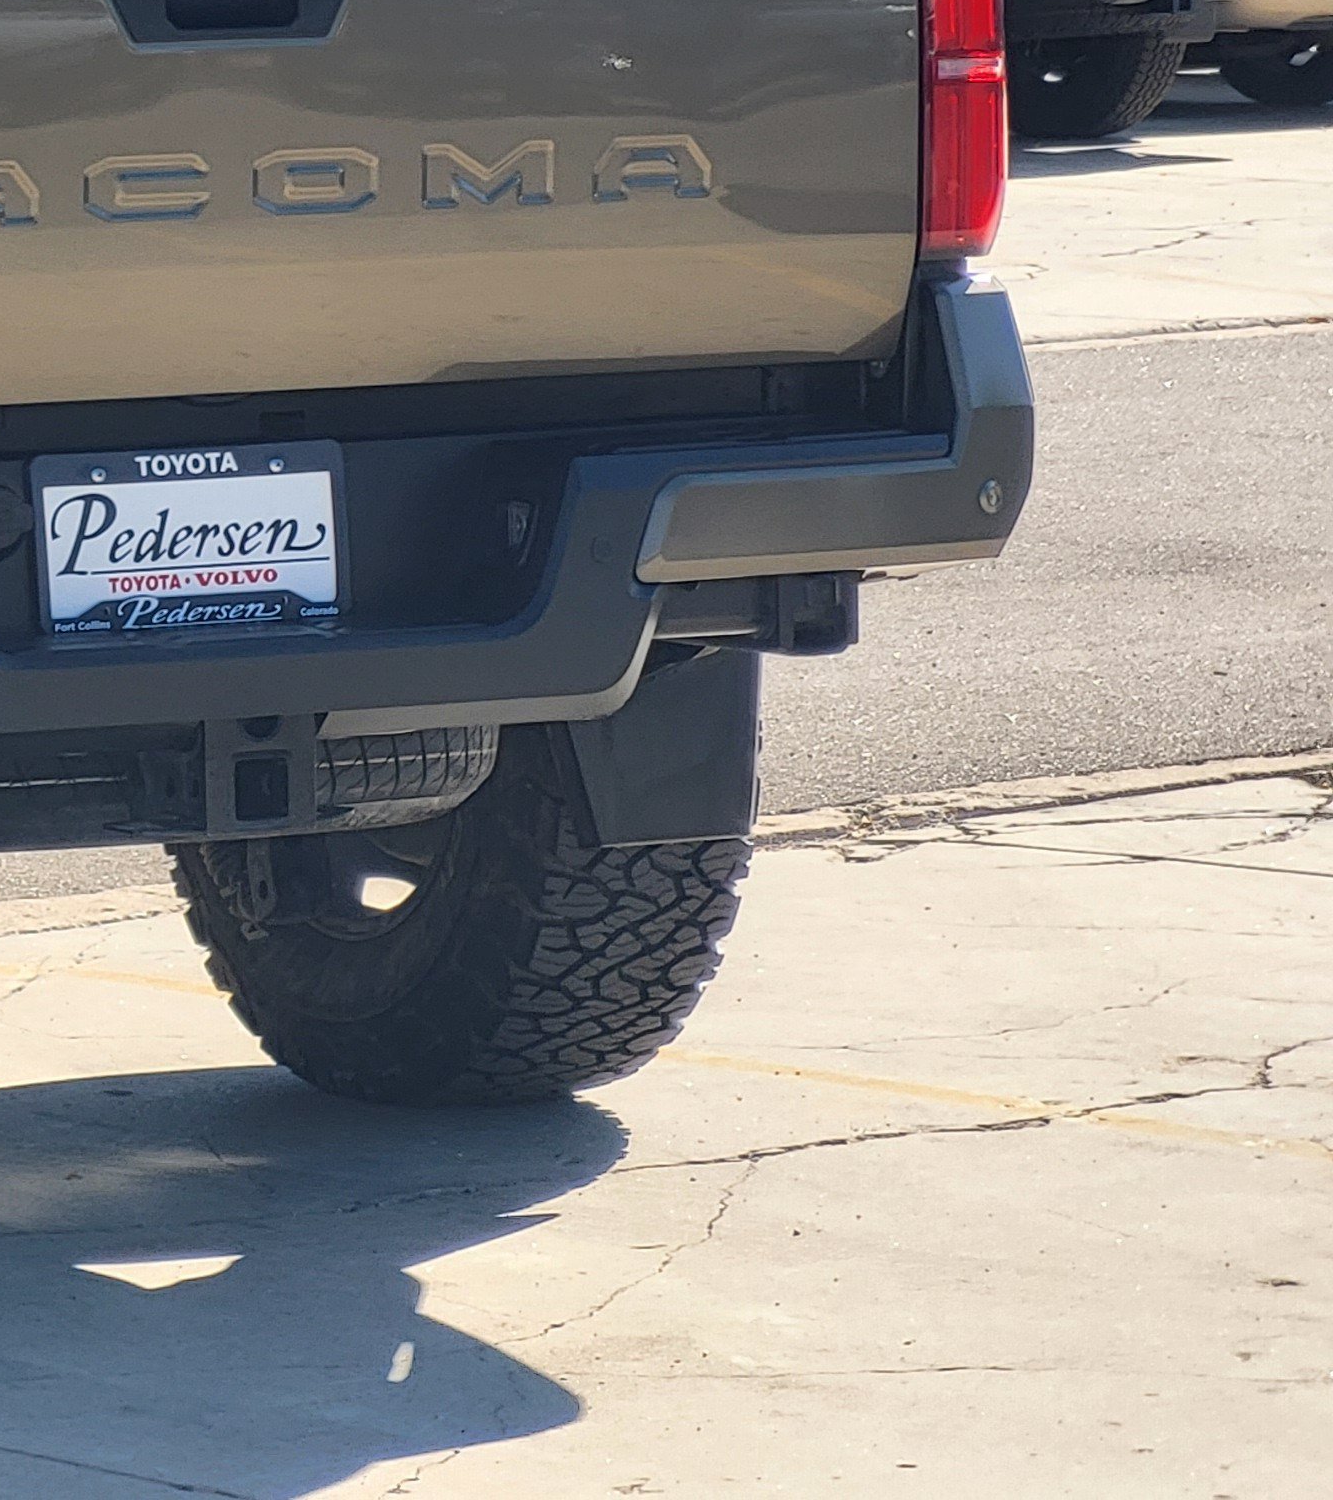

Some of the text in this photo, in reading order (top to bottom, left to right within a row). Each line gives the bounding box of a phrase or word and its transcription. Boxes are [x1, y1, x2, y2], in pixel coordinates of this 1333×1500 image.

[134, 452, 238, 477] TOYOTA
[51, 493, 327, 577] Pedersen
[108, 568, 278, 593] TOYOTA VOLVO
[117, 595, 282, 629] Pedersen
[300, 606, 339, 617] Colorado
[54, 619, 111, 632] Fort Collins
